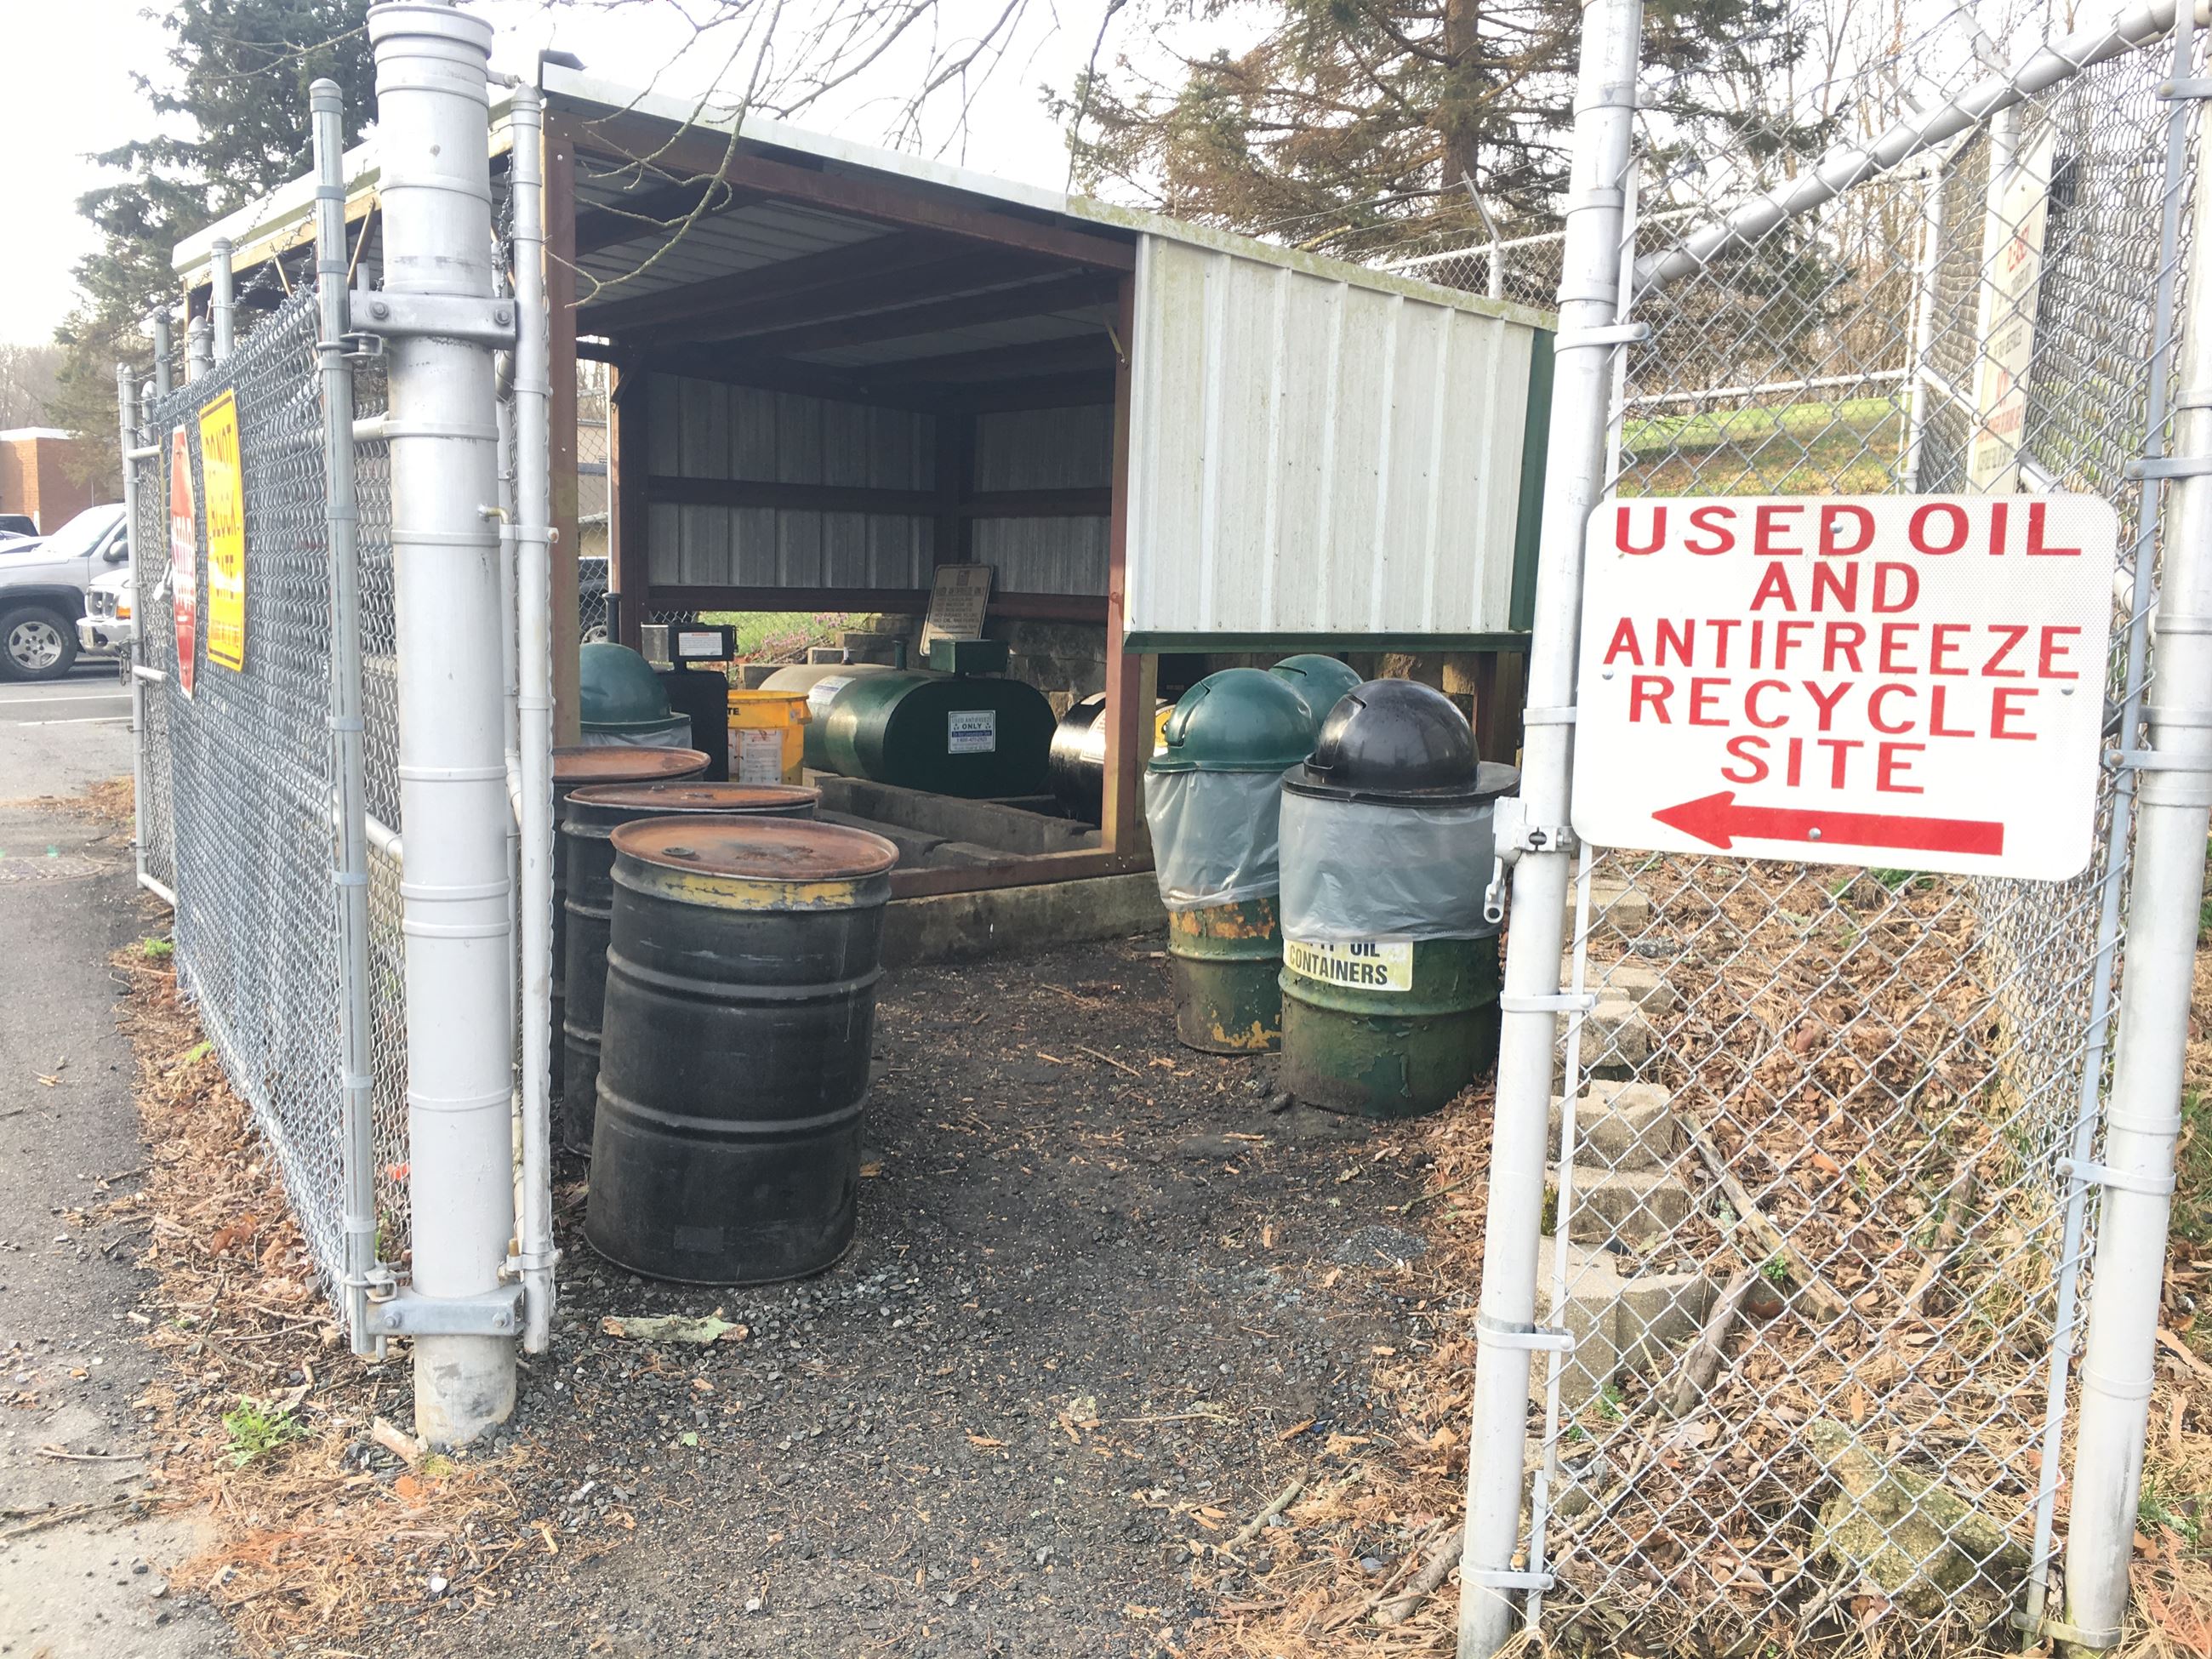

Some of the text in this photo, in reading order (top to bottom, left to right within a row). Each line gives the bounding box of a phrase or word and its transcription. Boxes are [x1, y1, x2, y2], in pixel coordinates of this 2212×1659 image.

[1616, 502, 2083, 556] USED OIL
[1750, 561, 1920, 613] AND
[1603, 617, 2082, 680] ANTIFREEZE
[1629, 675, 2040, 741] RECYCLE
[1719, 733, 1927, 795] SITE
[1290, 944, 1388, 985] CONTAINERS
